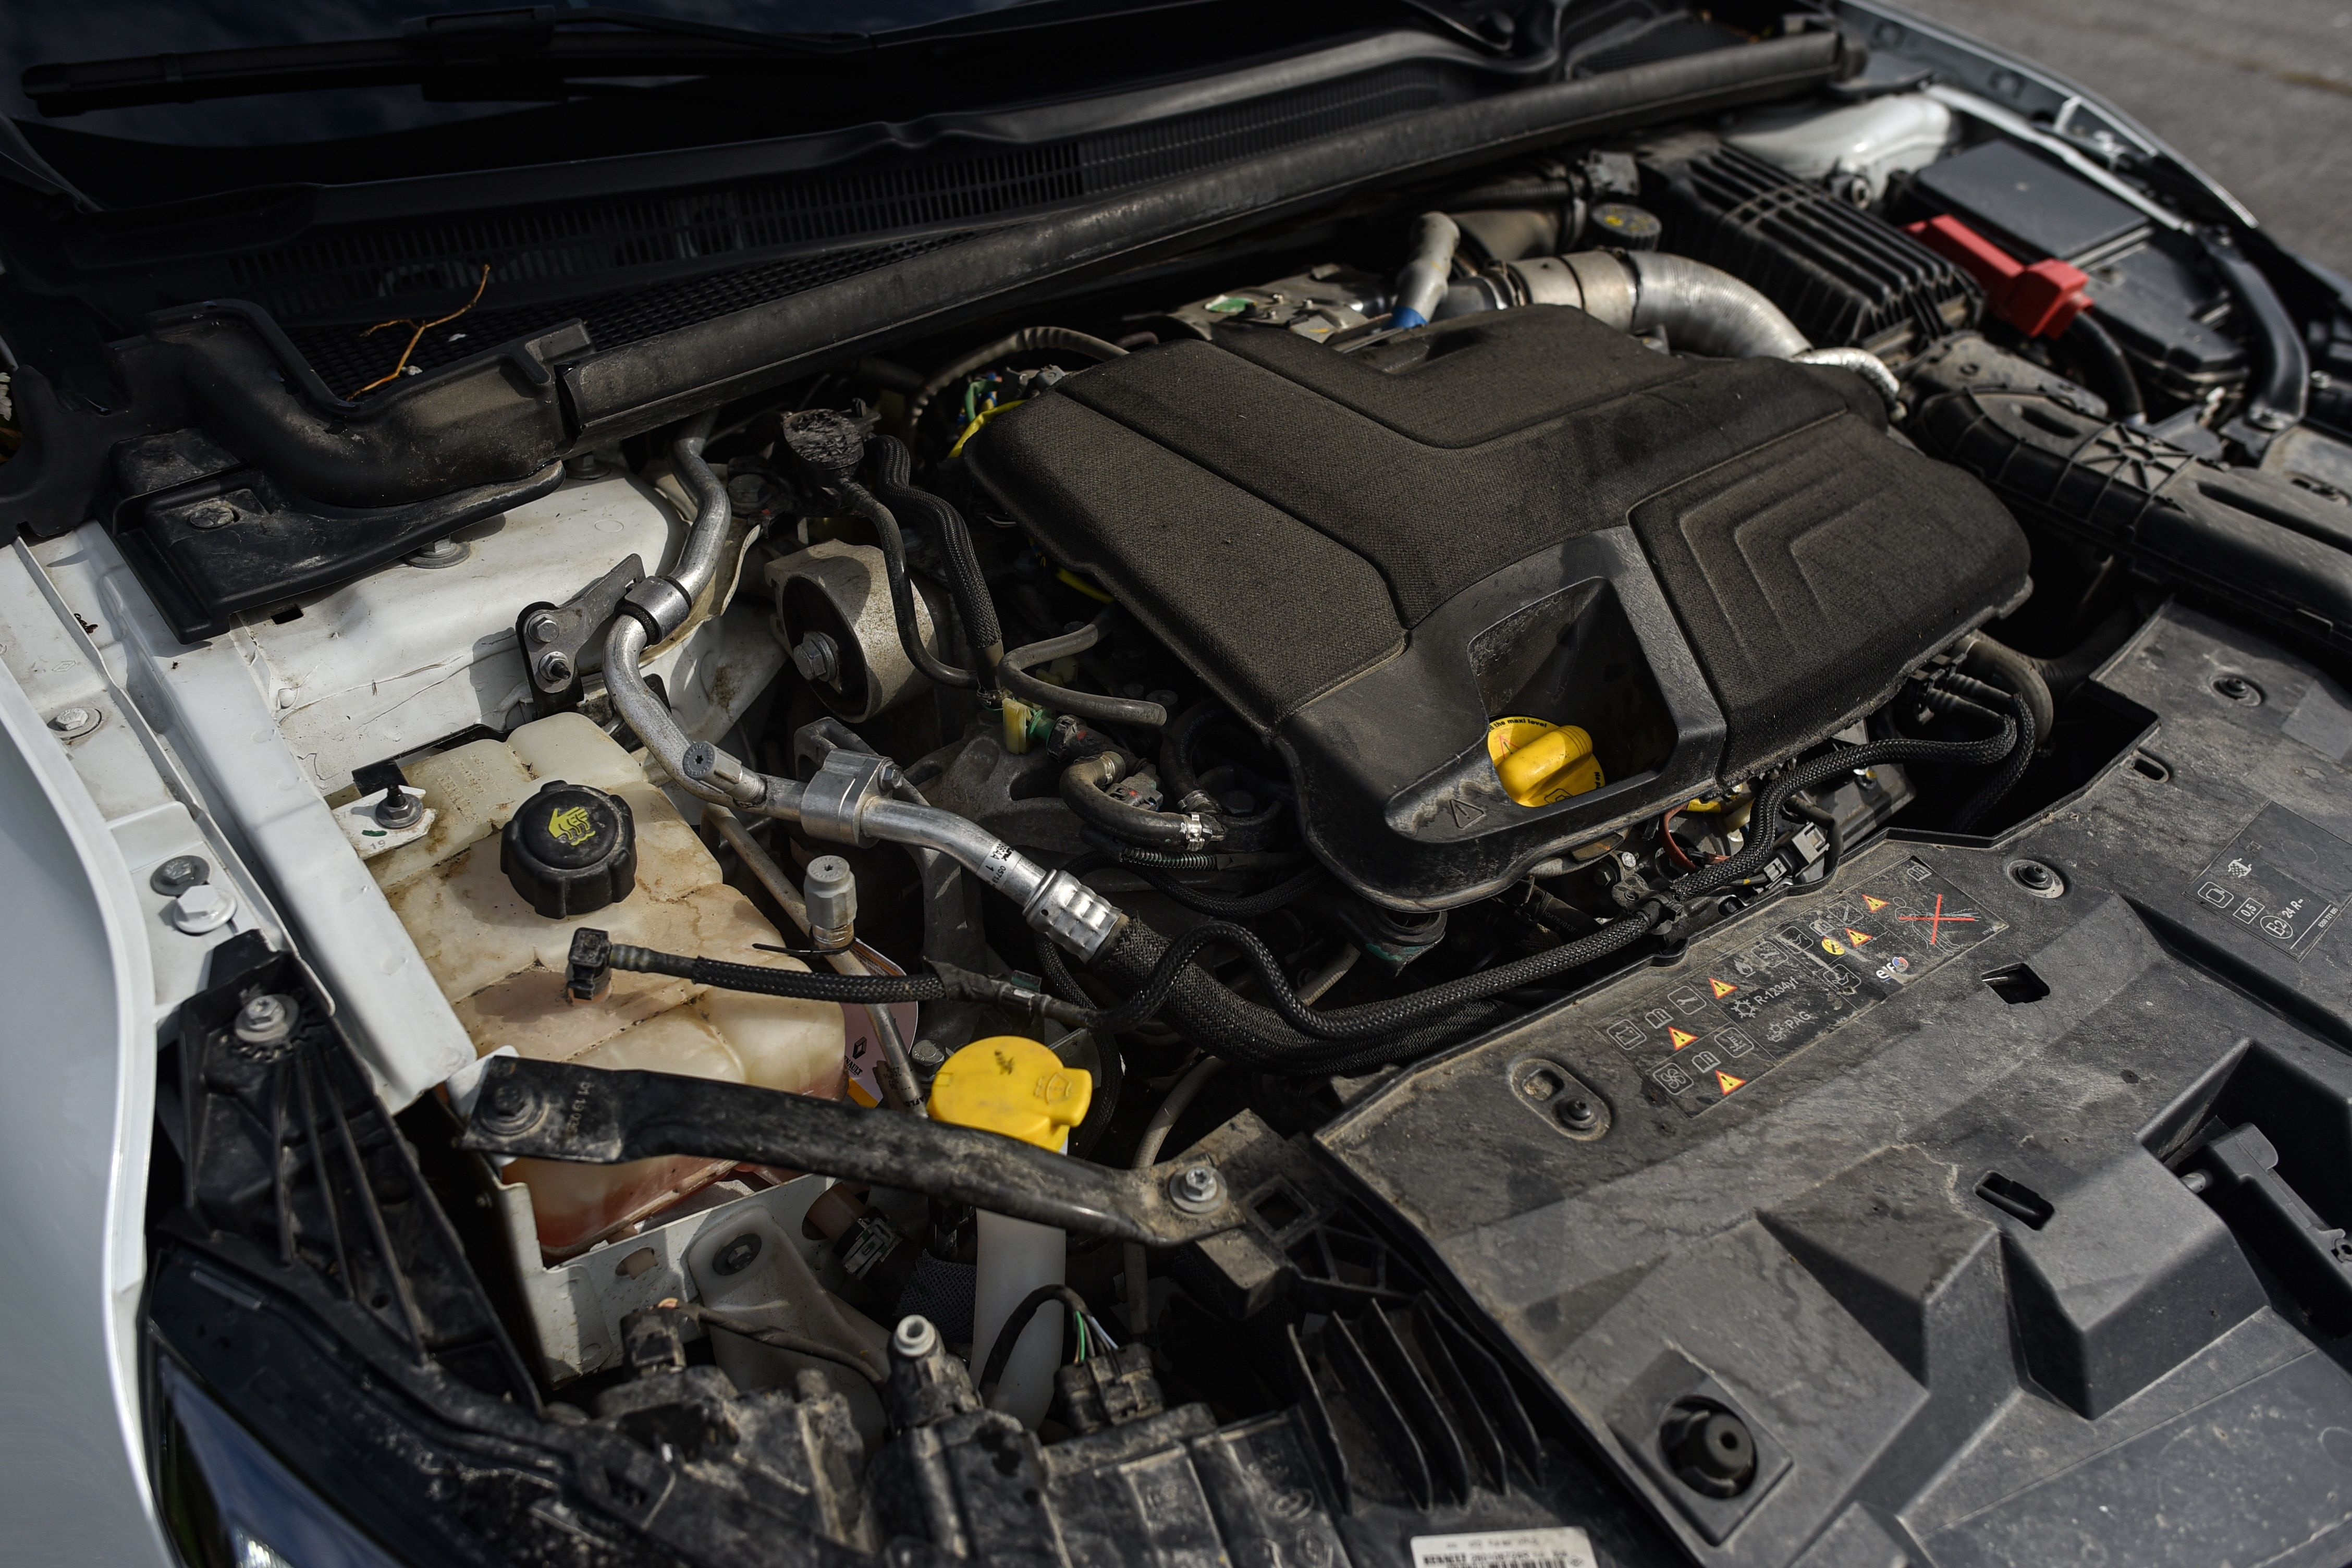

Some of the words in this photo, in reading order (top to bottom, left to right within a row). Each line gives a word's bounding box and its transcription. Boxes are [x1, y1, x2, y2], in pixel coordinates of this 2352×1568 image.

[1493, 720, 1505, 728] the
[1528, 718, 1547, 728] level
[1594, 771, 1601, 781] Ne
[370, 839, 386, 850] 19
[2240, 903, 2257, 917] 0,5
[2282, 907, 2296, 919] 24
[2290, 898, 2304, 910] R-
[2265, 920, 2287, 937] E2
[2318, 918, 2328, 928] 8200
[1876, 962, 1896, 979] elf
[1753, 975, 1800, 1007] R-1234yf
[1784, 1011, 1811, 1031] PAG
